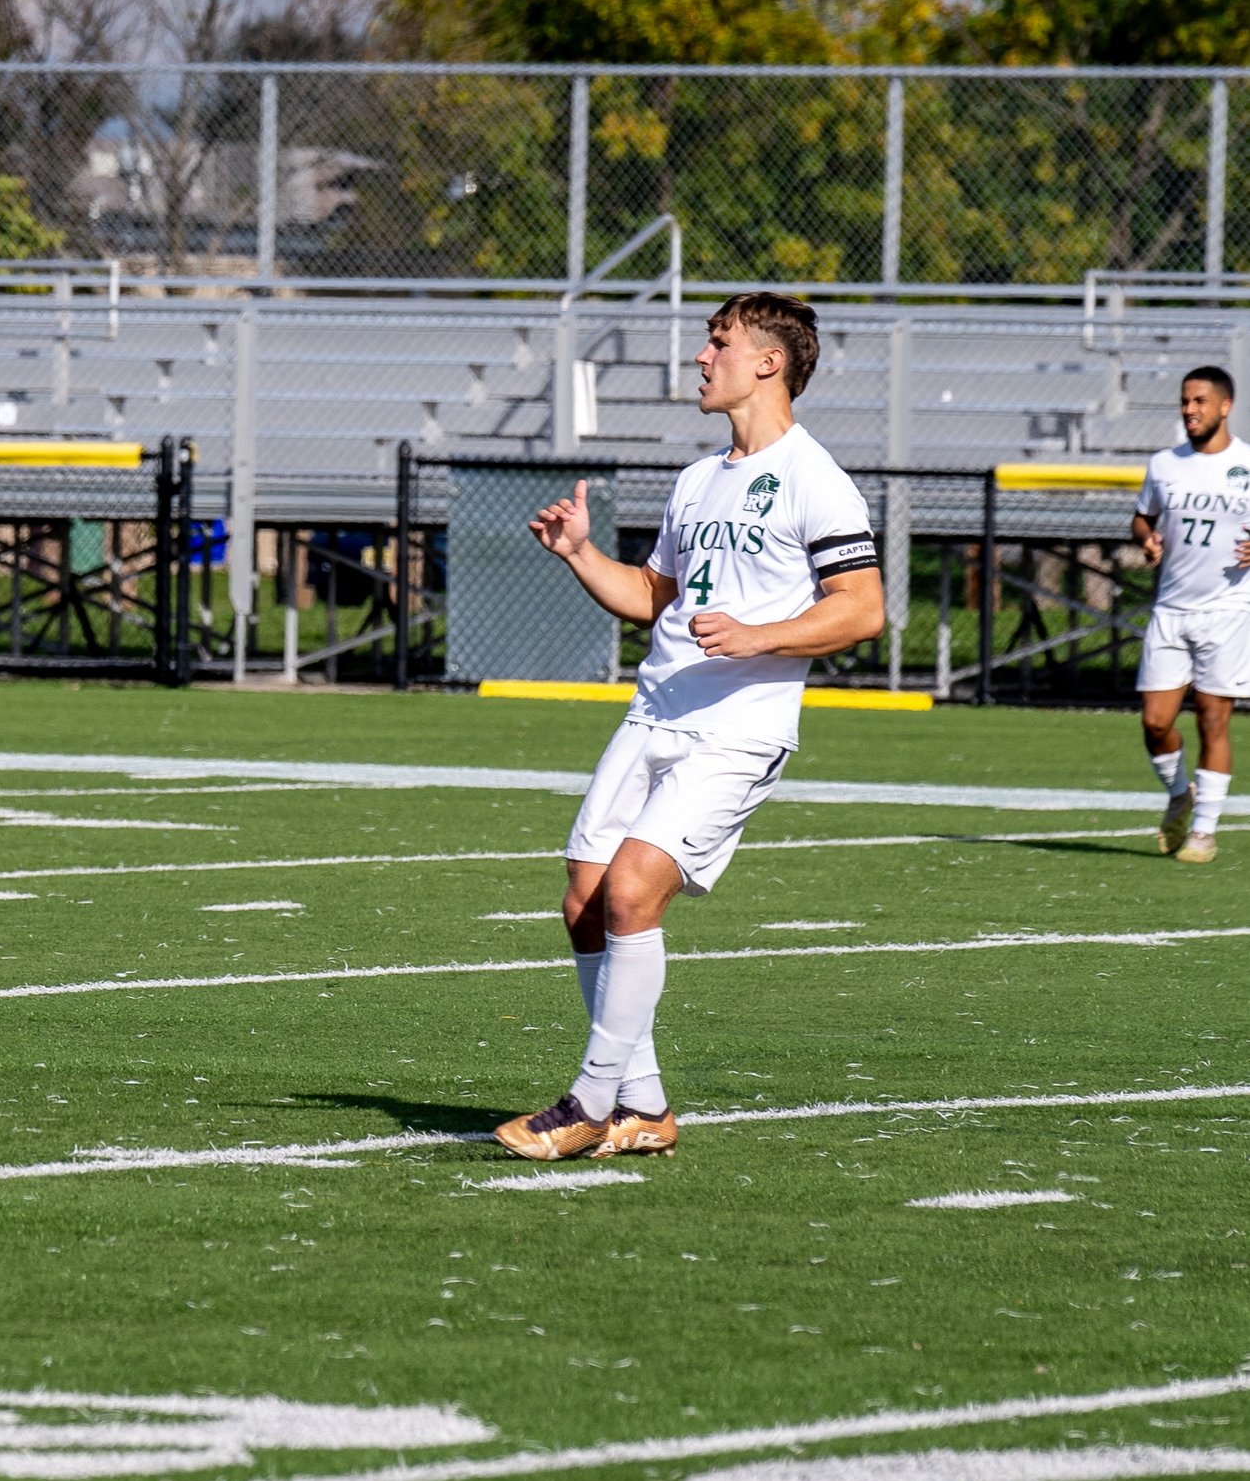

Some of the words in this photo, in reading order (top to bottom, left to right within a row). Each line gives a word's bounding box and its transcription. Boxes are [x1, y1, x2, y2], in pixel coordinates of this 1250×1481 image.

[1166, 493, 1248, 516] LIONS
[678, 521, 766, 555] LIONS
[1183, 518, 1216, 547] 77
[838, 544, 874, 557] CAPTA
[687, 560, 713, 605] 4
